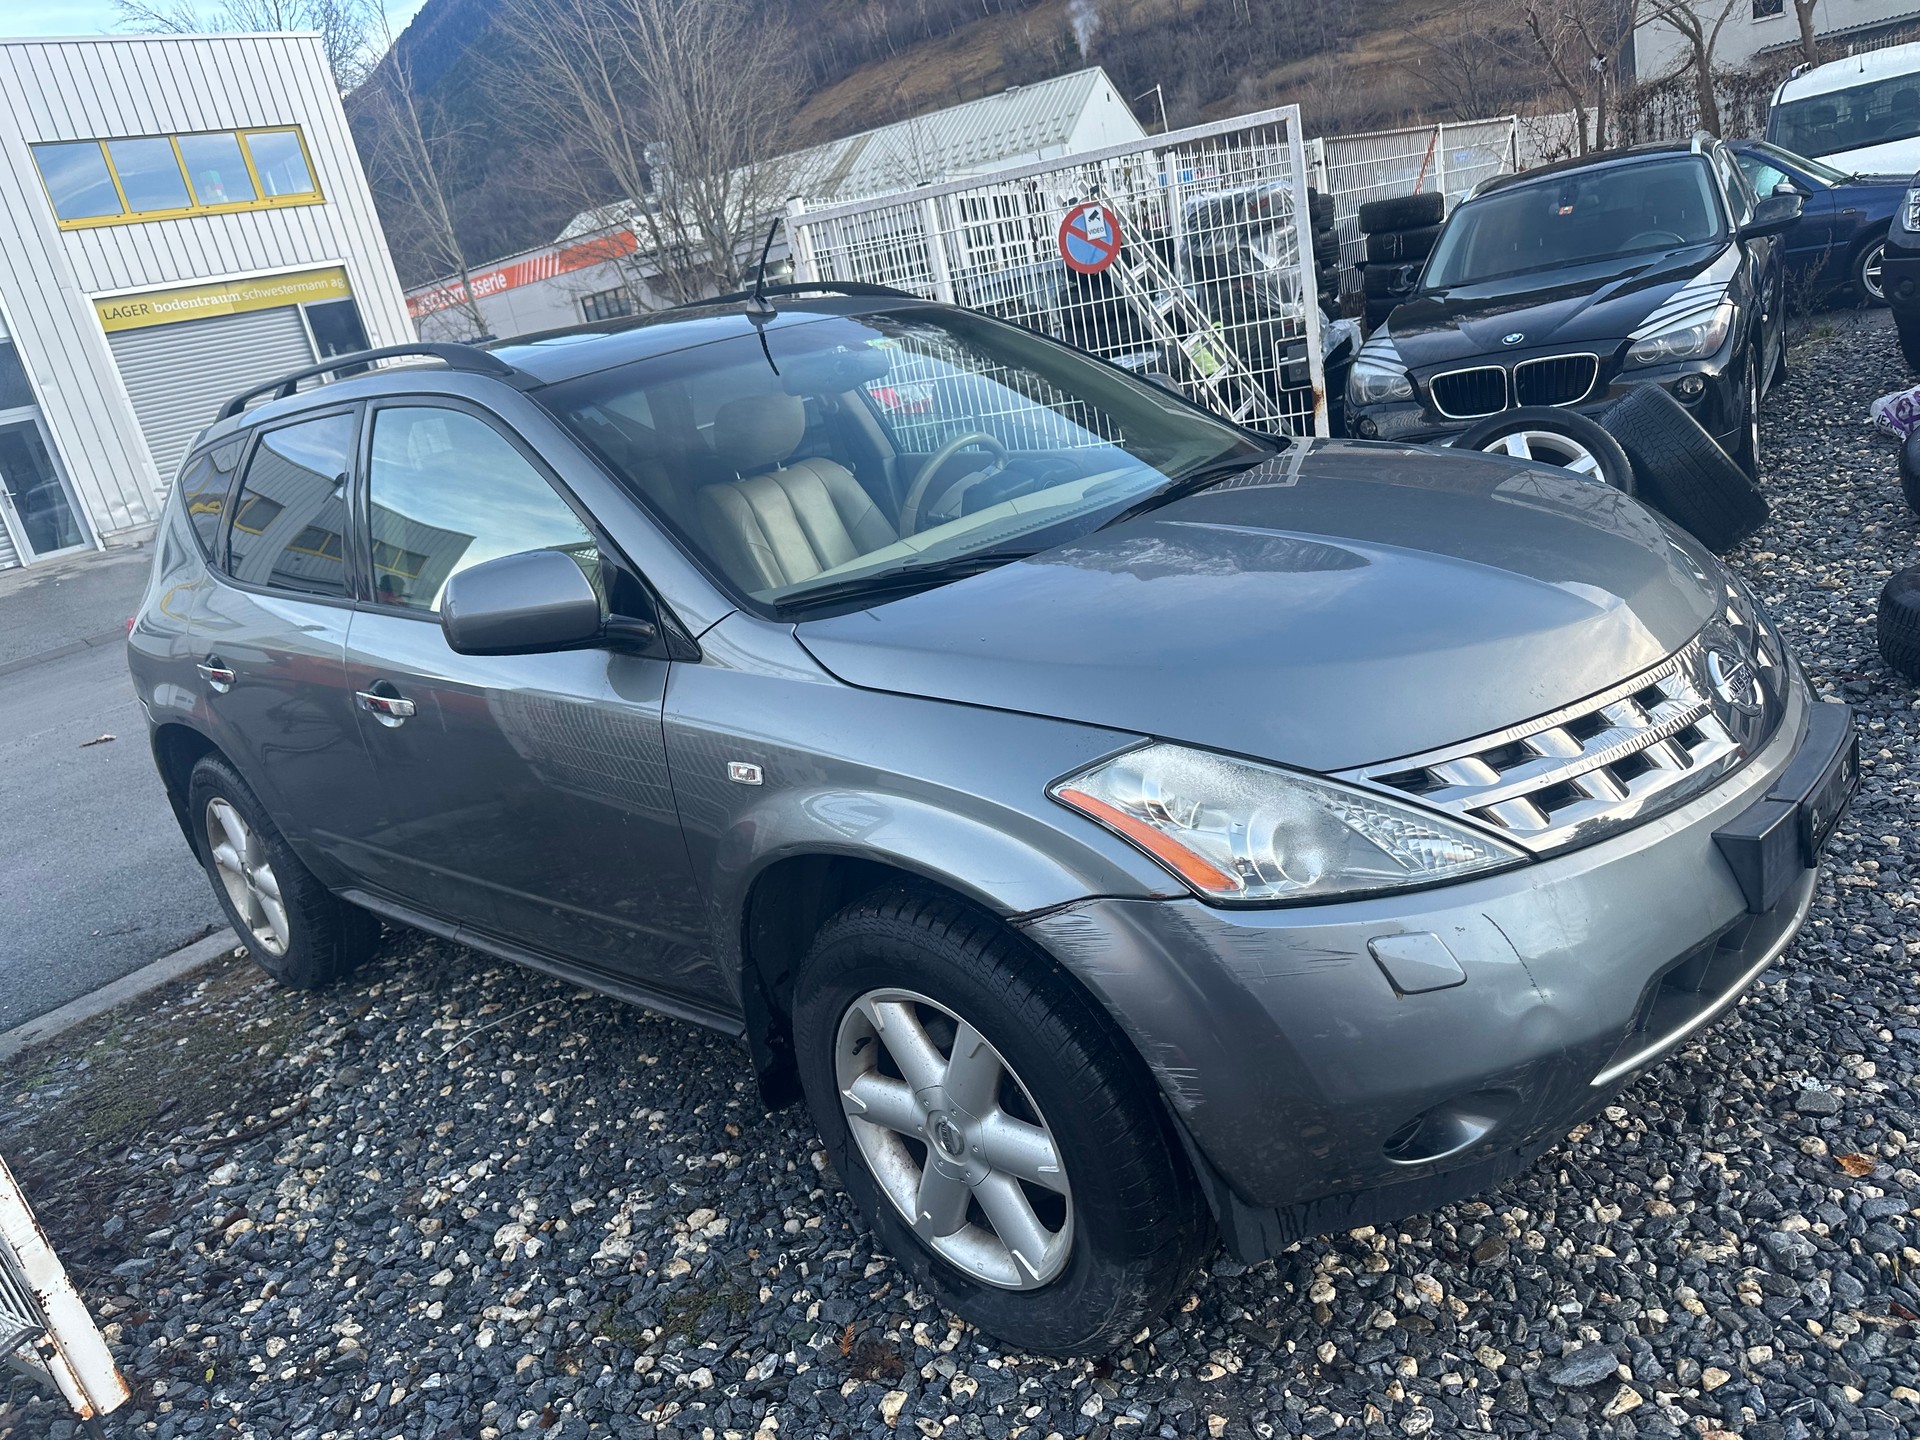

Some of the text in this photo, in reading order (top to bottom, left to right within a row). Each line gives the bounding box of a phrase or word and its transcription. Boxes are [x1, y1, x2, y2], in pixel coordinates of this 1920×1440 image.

[1087, 226, 1104, 235] VIDEO
[102, 277, 345, 321] LAGER bodentraum schwestermann ag
